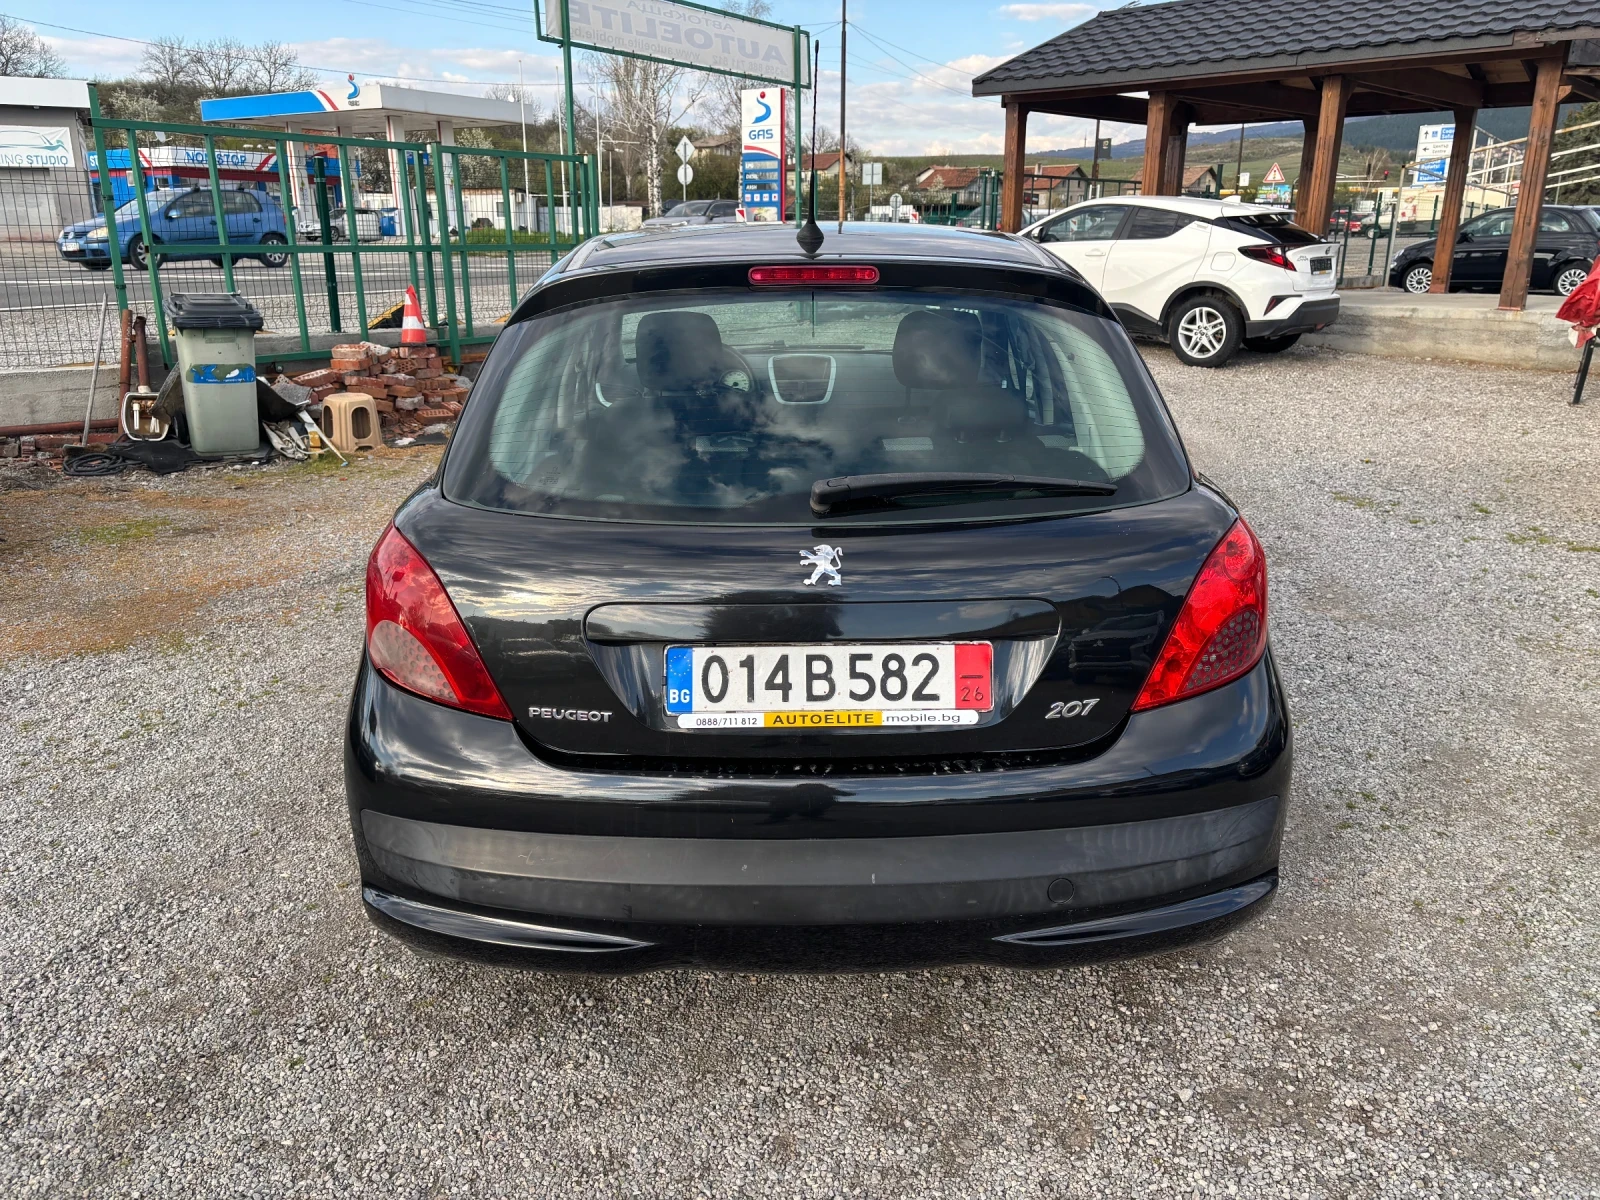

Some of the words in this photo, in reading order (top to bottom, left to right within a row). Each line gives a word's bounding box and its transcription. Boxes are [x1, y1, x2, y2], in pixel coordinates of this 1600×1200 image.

[749, 129, 774, 140] GAS
[0, 154, 23, 165] ING
[26, 155, 69, 165] STUDIO
[669, 688, 691, 704] BG
[960, 686, 984, 702] 26
[528, 706, 613, 723] PEUGEOT
[1044, 698, 1101, 720] 207
[740, 716, 758, 726] 812
